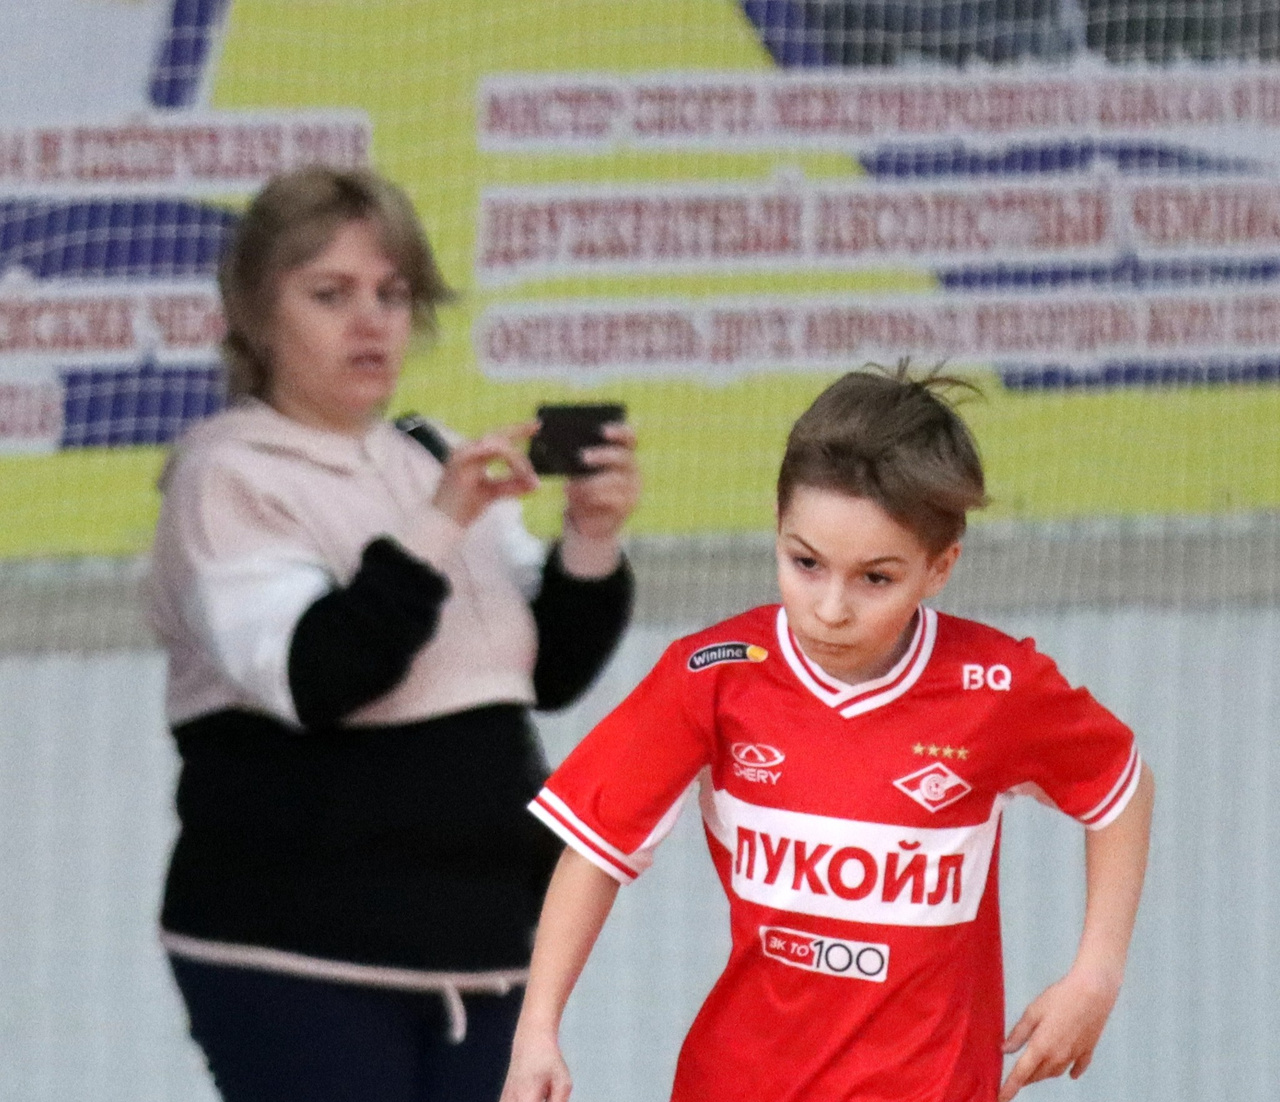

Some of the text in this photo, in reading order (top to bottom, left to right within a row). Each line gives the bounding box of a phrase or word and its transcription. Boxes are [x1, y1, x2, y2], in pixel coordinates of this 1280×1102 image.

[693, 647, 743, 666] Winline
[963, 664, 1013, 691] BQ
[734, 826, 966, 905] ЛУКОЙЛ
[813, 939, 885, 976] 100
